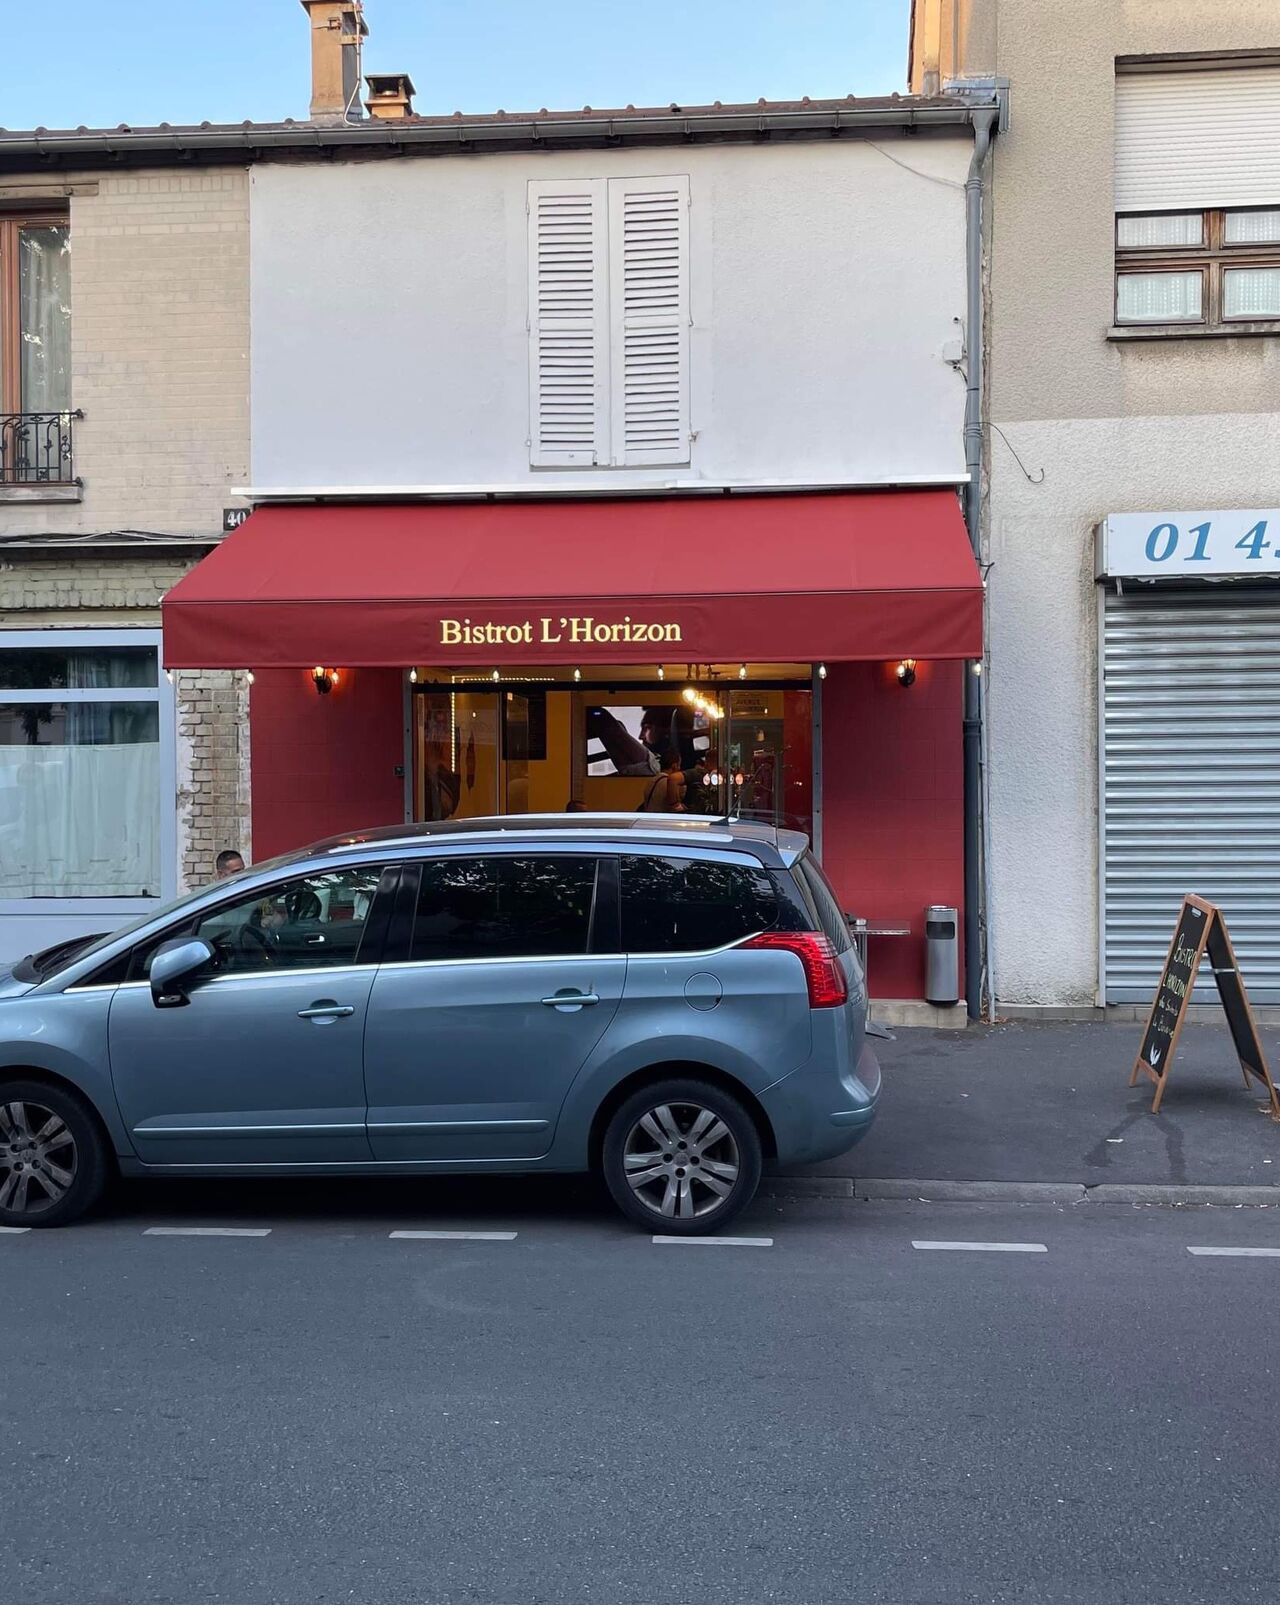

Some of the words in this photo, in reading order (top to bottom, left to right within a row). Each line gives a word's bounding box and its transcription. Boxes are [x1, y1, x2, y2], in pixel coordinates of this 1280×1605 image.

[227, 511, 247, 527] 40
[1145, 522, 1212, 562] 01
[1234, 520, 1280, 560] 4
[440, 618, 533, 645] Bistrot
[540, 616, 683, 643] L'Horizon
